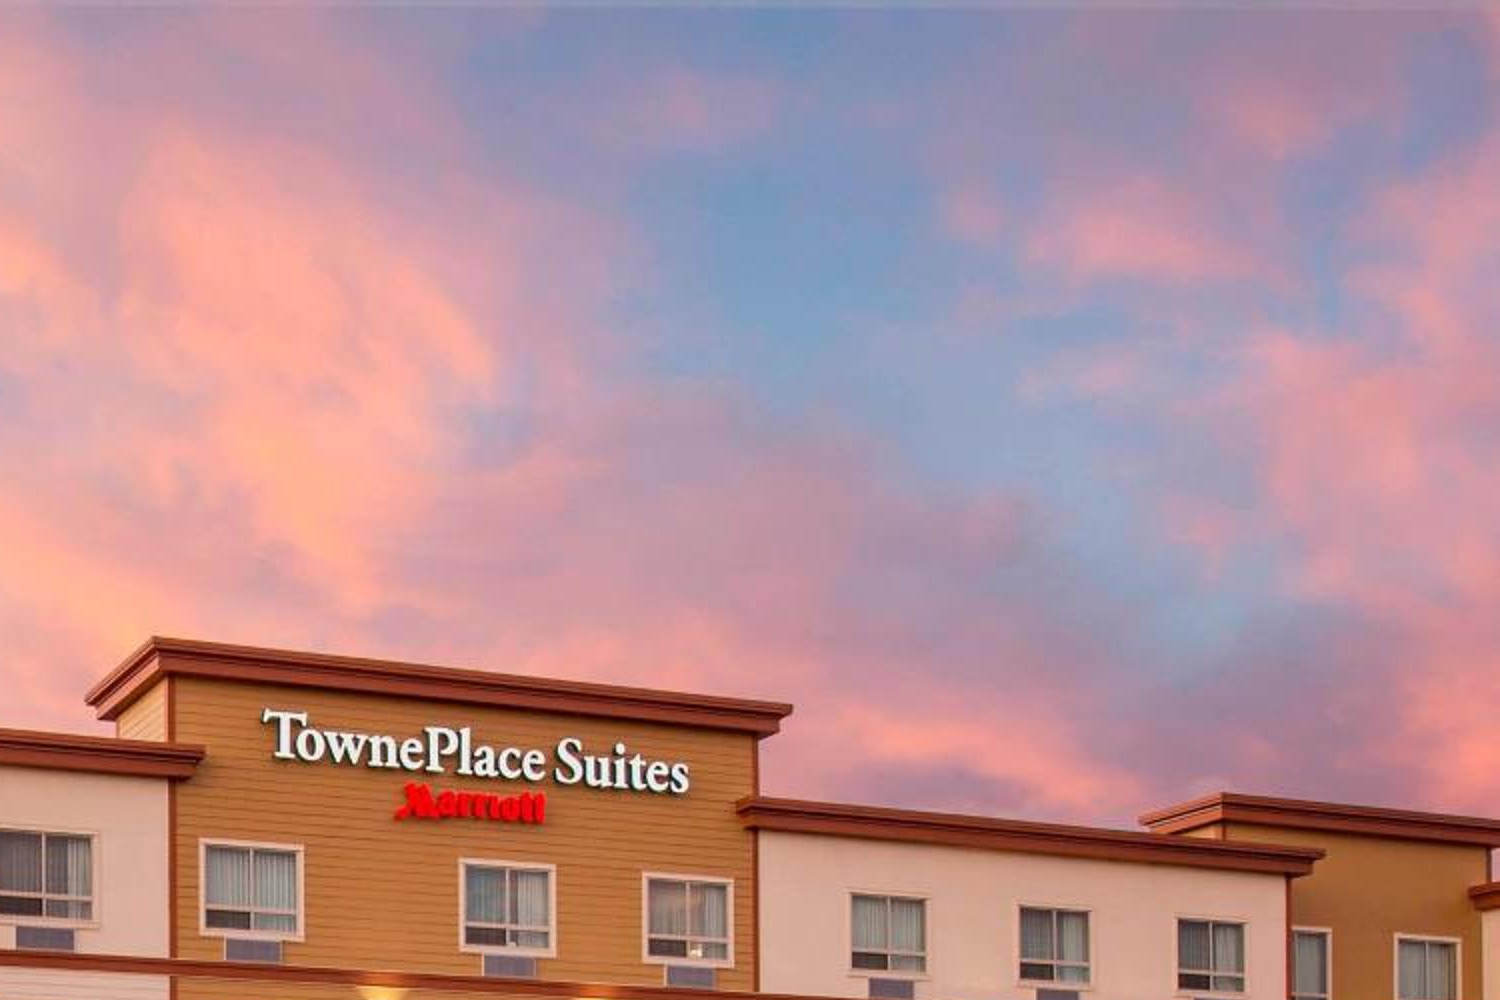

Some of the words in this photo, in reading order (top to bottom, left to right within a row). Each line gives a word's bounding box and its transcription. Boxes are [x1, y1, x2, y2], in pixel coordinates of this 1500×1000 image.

[263, 709, 545, 781] TownePlace
[555, 738, 690, 793] Suites
[396, 783, 547, 824] Marriott
